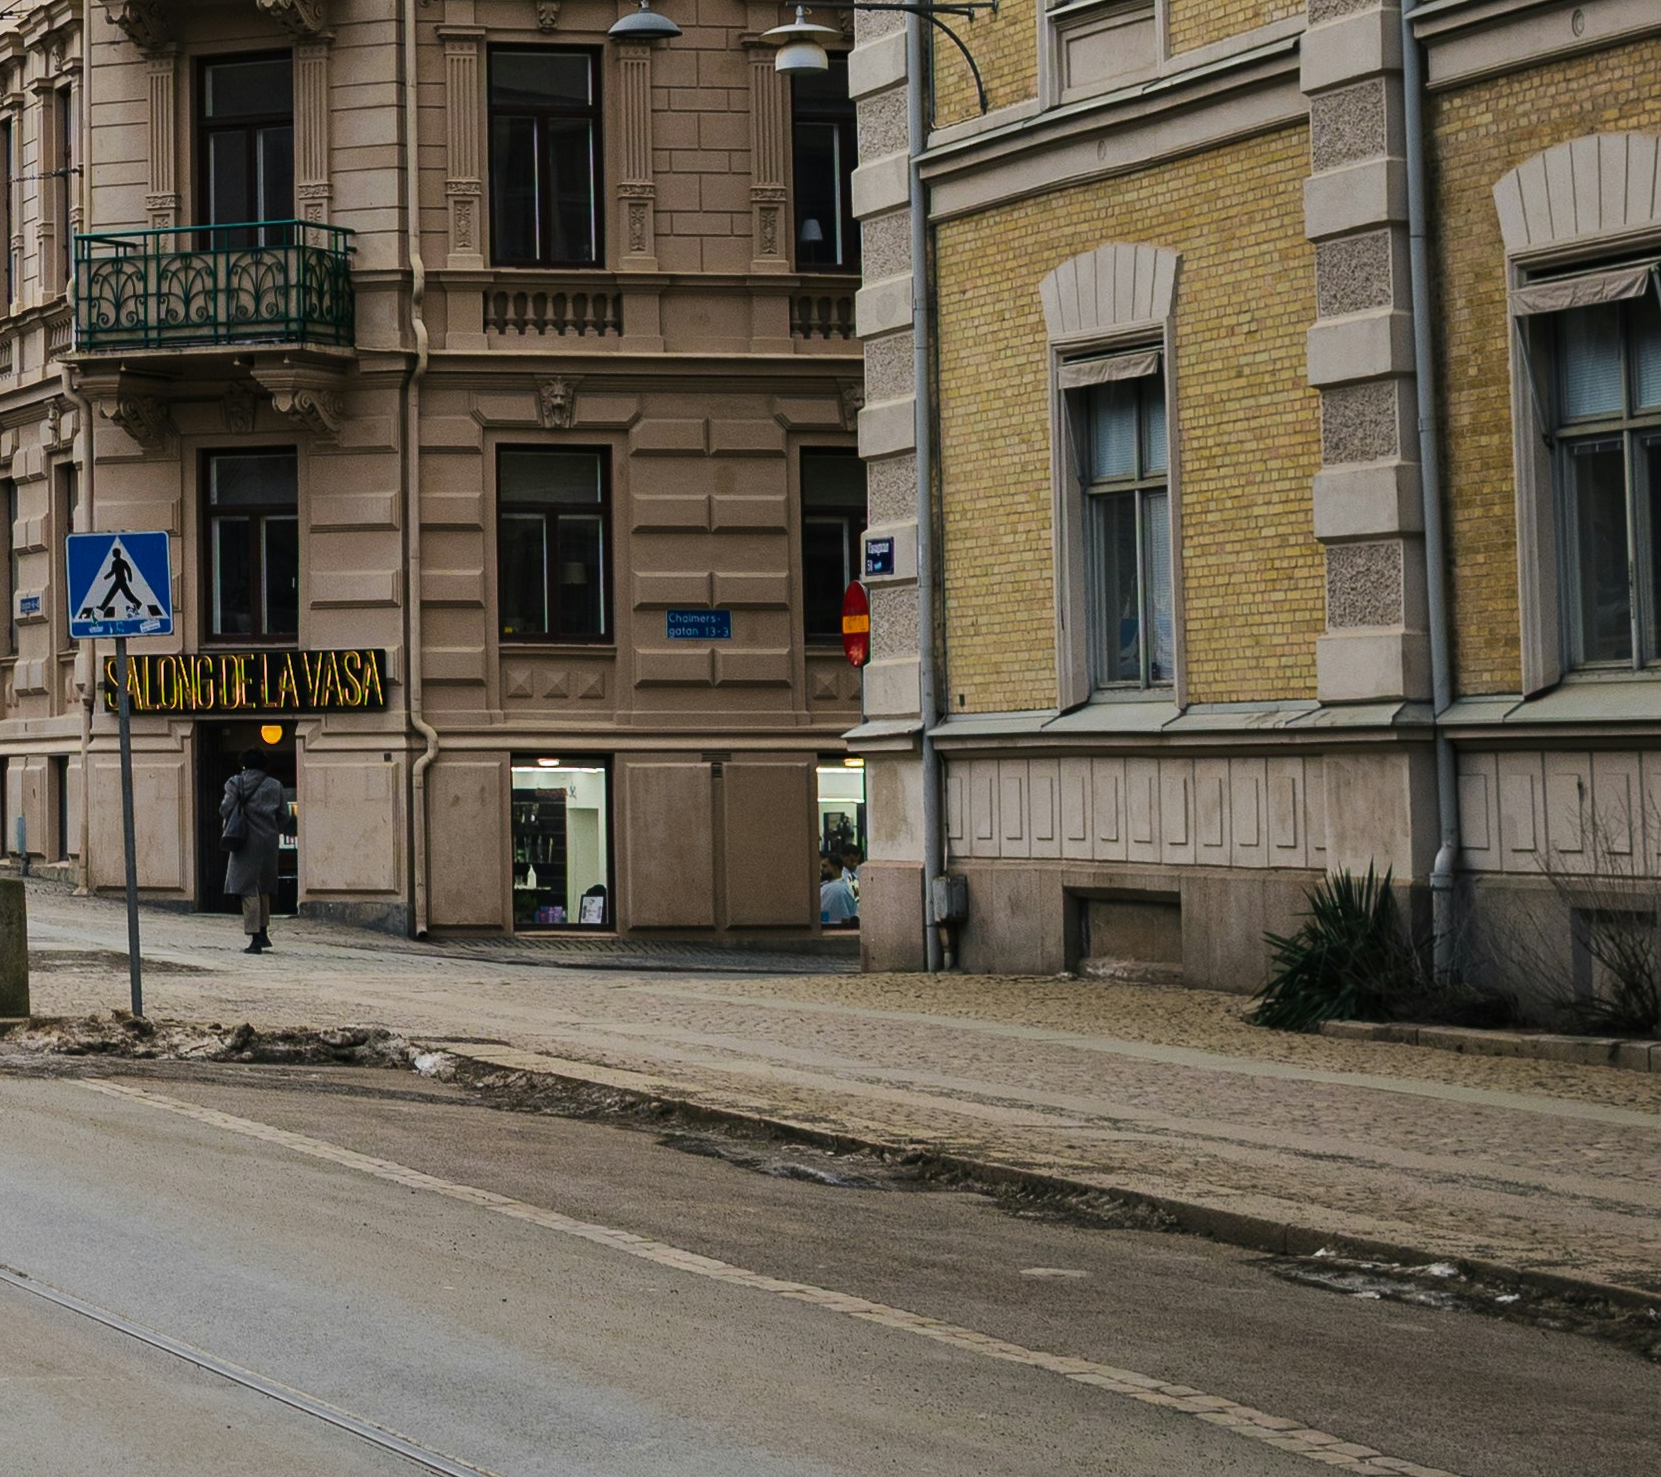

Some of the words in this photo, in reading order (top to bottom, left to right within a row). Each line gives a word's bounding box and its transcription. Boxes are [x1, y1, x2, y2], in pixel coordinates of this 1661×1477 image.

[668, 612, 721, 623] Chalmers-
[668, 627, 699, 639] gatan
[105, 654, 215, 711] SALONG
[218, 653, 256, 710] DE
[260, 652, 299, 709] LA
[302, 650, 385, 708] VASA
